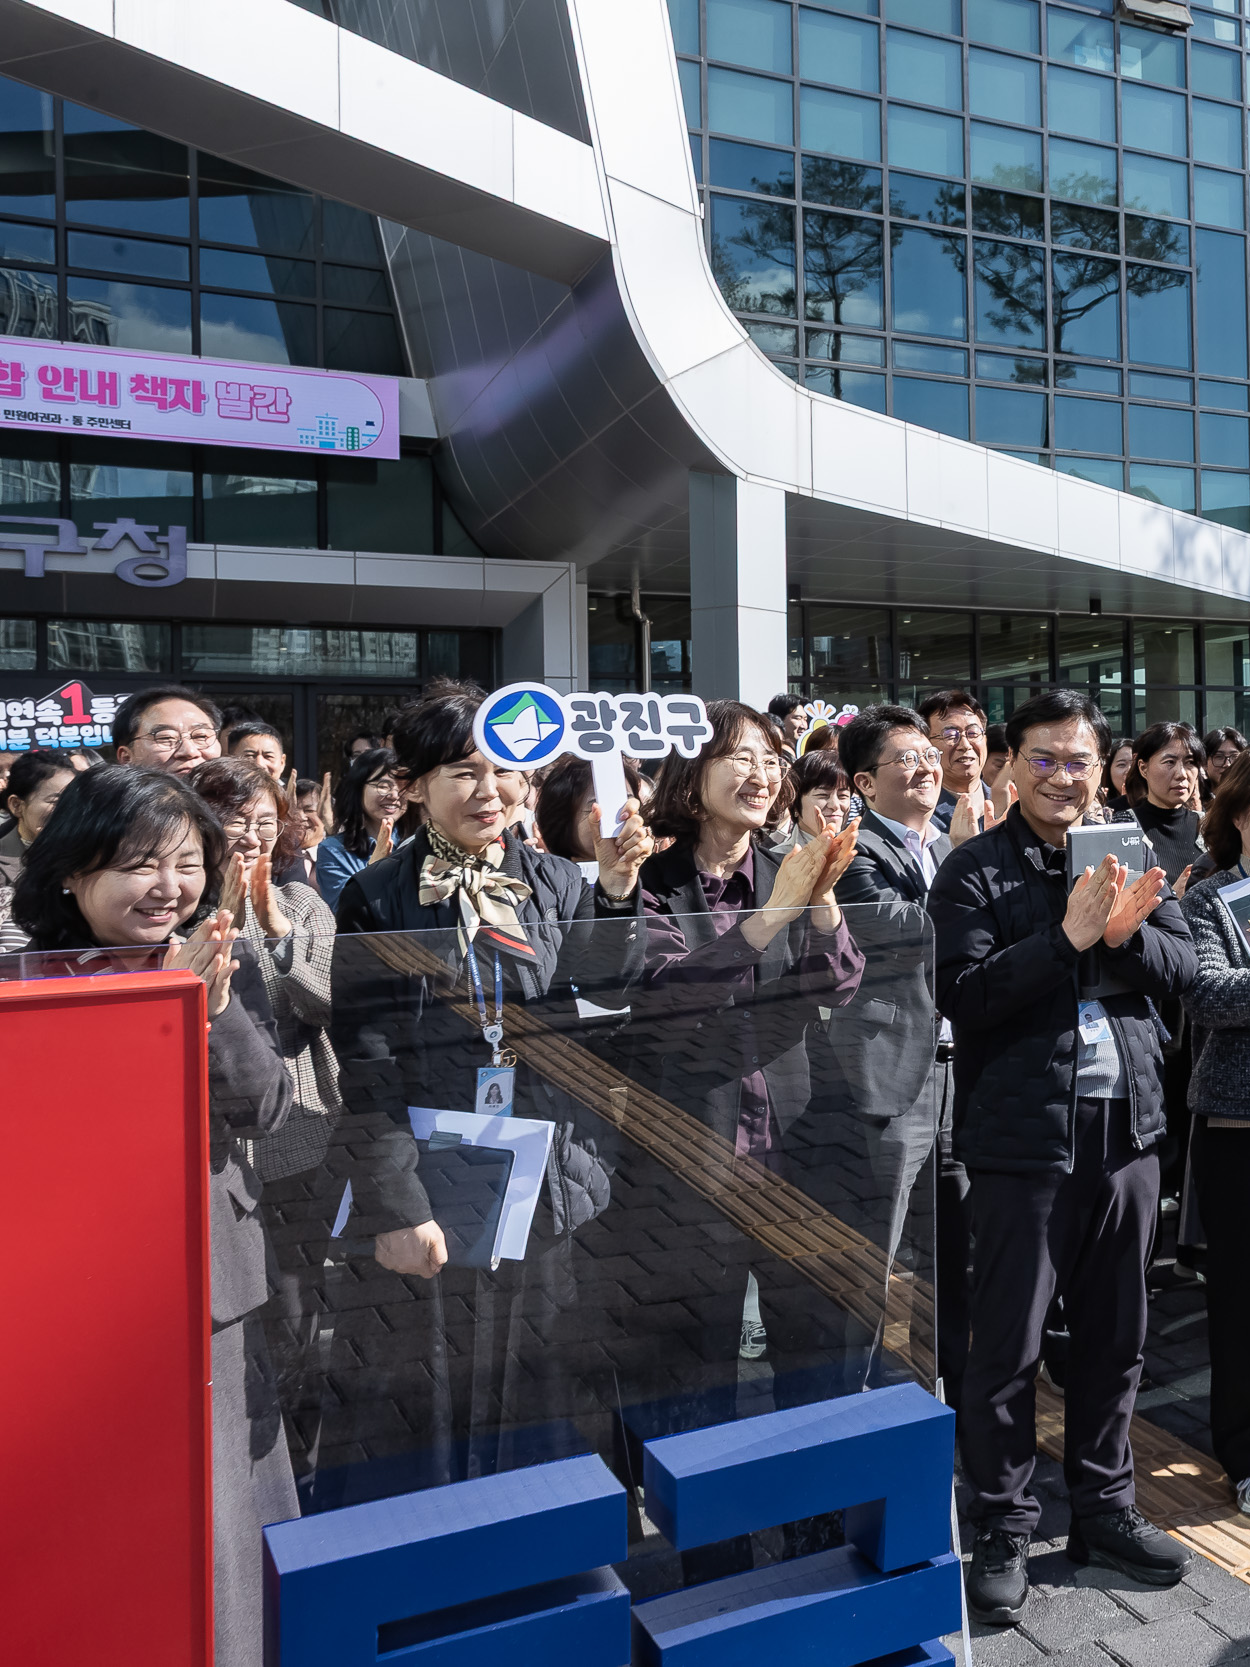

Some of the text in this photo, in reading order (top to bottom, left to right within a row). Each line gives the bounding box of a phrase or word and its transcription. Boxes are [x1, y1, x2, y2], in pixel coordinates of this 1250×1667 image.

[3, 409, 62, 424] 민원여권과
[72, 415, 84, 426] 동
[87, 416, 131, 430] 주민센터
[37, 365, 118, 406] 안내
[130, 373, 207, 413] 책자
[215, 380, 292, 423] 발간
[0, 515, 187, 587] 구청
[0, 729, 31, 751] 분
[570, 699, 707, 751] 광진구
